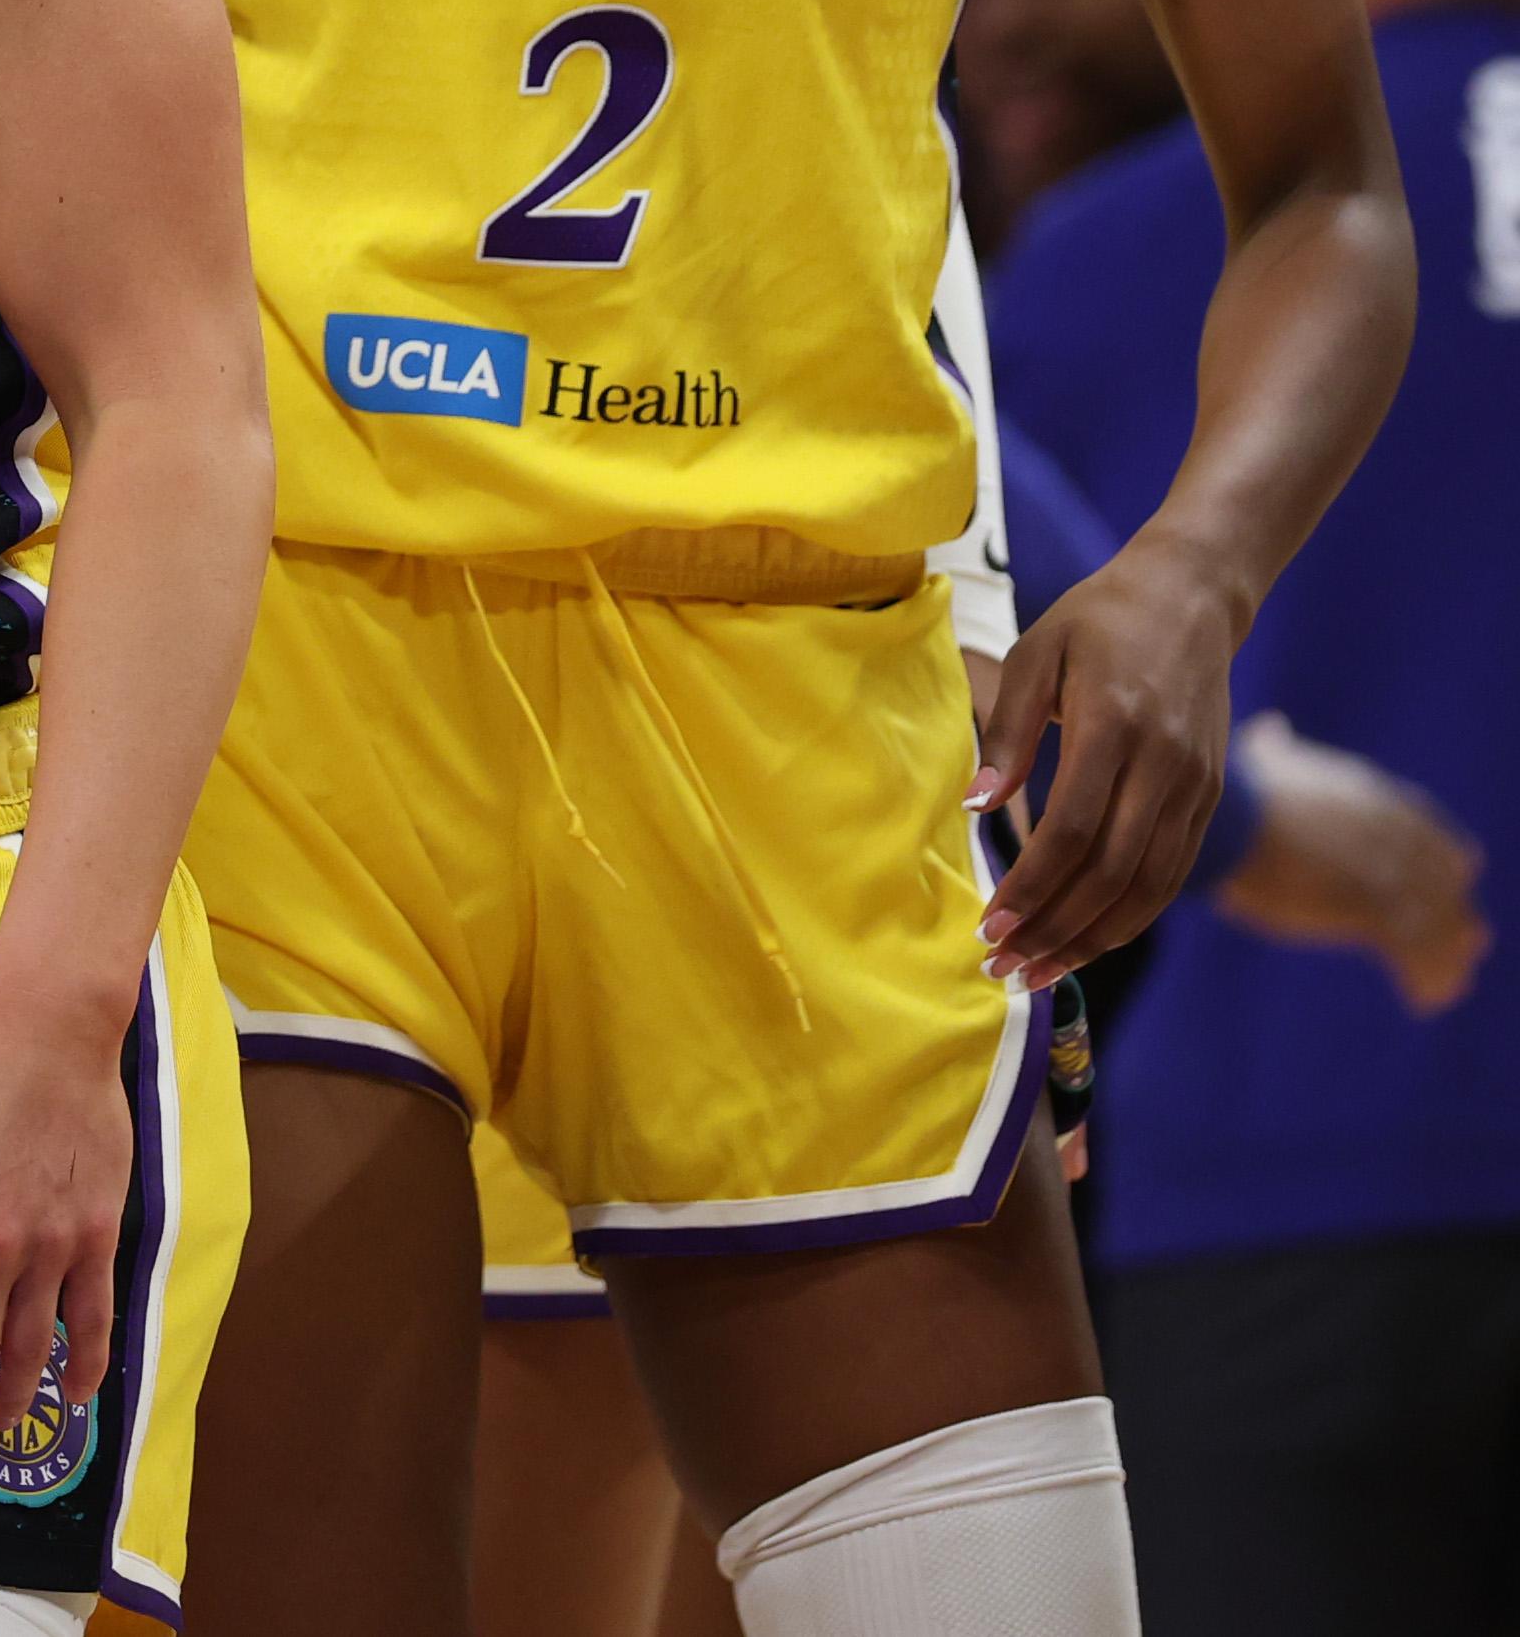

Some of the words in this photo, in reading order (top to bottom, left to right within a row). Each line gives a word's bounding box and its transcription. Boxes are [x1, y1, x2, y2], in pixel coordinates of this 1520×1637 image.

[476, 3, 674, 270] 2
[347, 335, 500, 399] UCLA
[539, 358, 740, 428] Health
